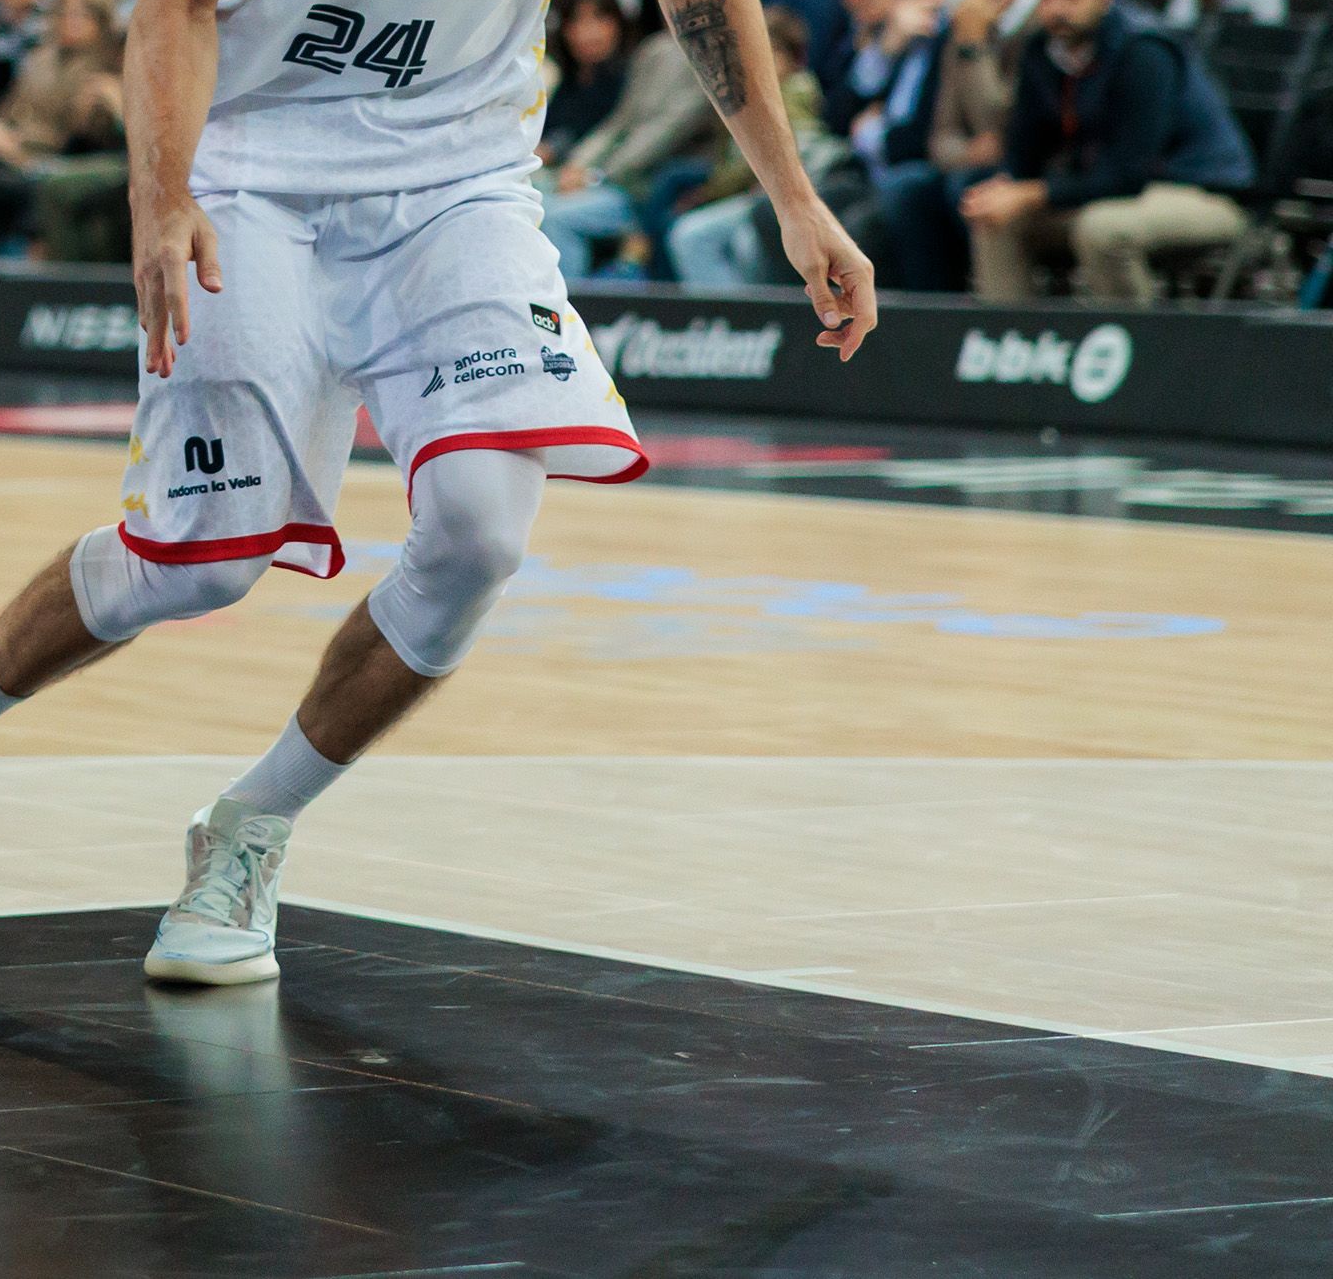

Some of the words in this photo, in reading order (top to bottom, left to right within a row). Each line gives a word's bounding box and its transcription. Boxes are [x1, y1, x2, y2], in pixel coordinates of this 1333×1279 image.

[282, 3, 435, 88] 24
[534, 314, 556, 331] acb
[454, 347, 517, 371] andorra
[957, 327, 1072, 386] bbk
[167, 484, 208, 499] Andorra
[211, 480, 226, 493] la
[228, 475, 261, 490] Vella
